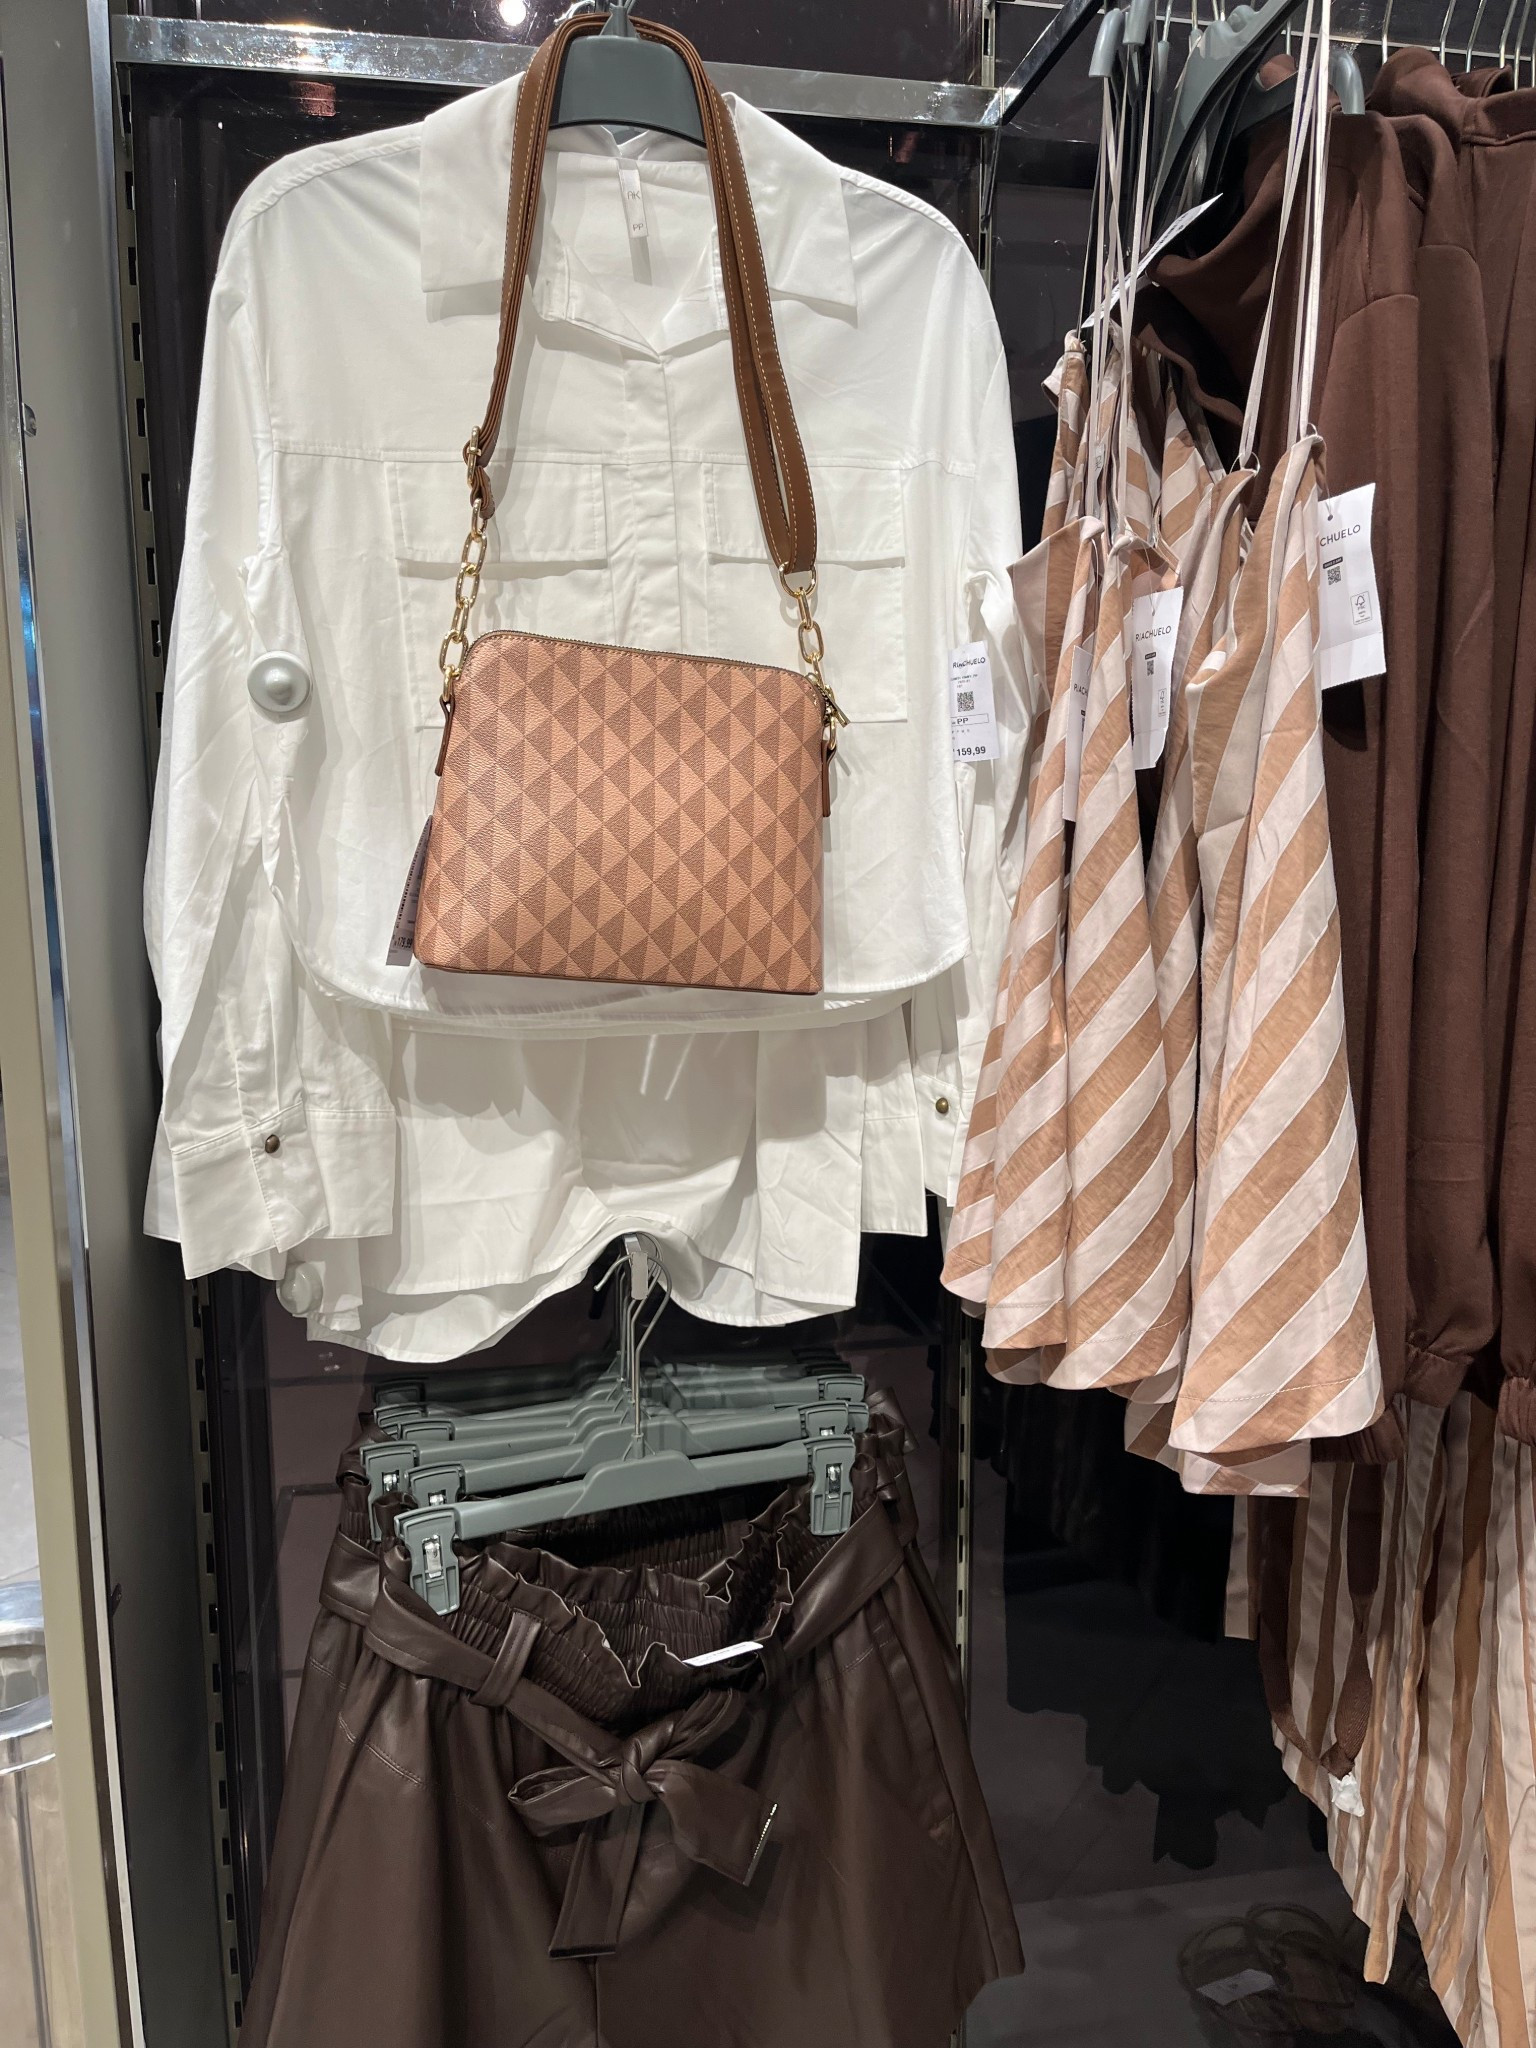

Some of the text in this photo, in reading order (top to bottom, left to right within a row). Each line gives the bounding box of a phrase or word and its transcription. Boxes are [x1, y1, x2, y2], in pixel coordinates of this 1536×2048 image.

[632, 223, 644, 231] PP
[1319, 524, 1361, 547] CHUELO
[1135, 625, 1172, 641] RIACHUELO
[956, 717, 969, 725] PP
[956, 745, 986, 756] 159,99
